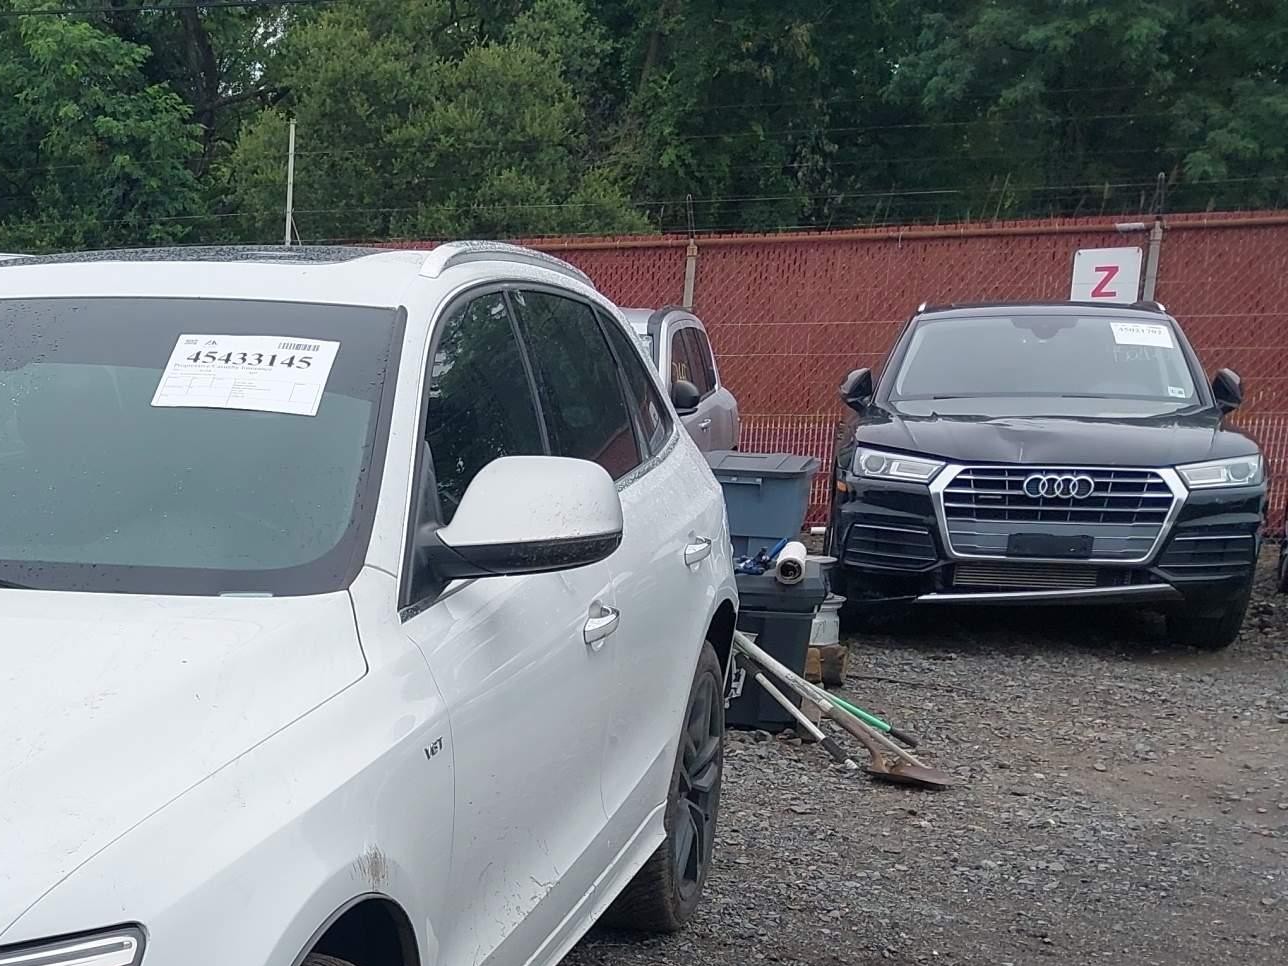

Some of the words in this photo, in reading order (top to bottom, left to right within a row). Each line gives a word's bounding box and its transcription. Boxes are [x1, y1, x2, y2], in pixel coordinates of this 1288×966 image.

[1091, 265, 1119, 298] Z
[186, 350, 313, 370] 45433145
[424, 736, 443, 760] V6T
